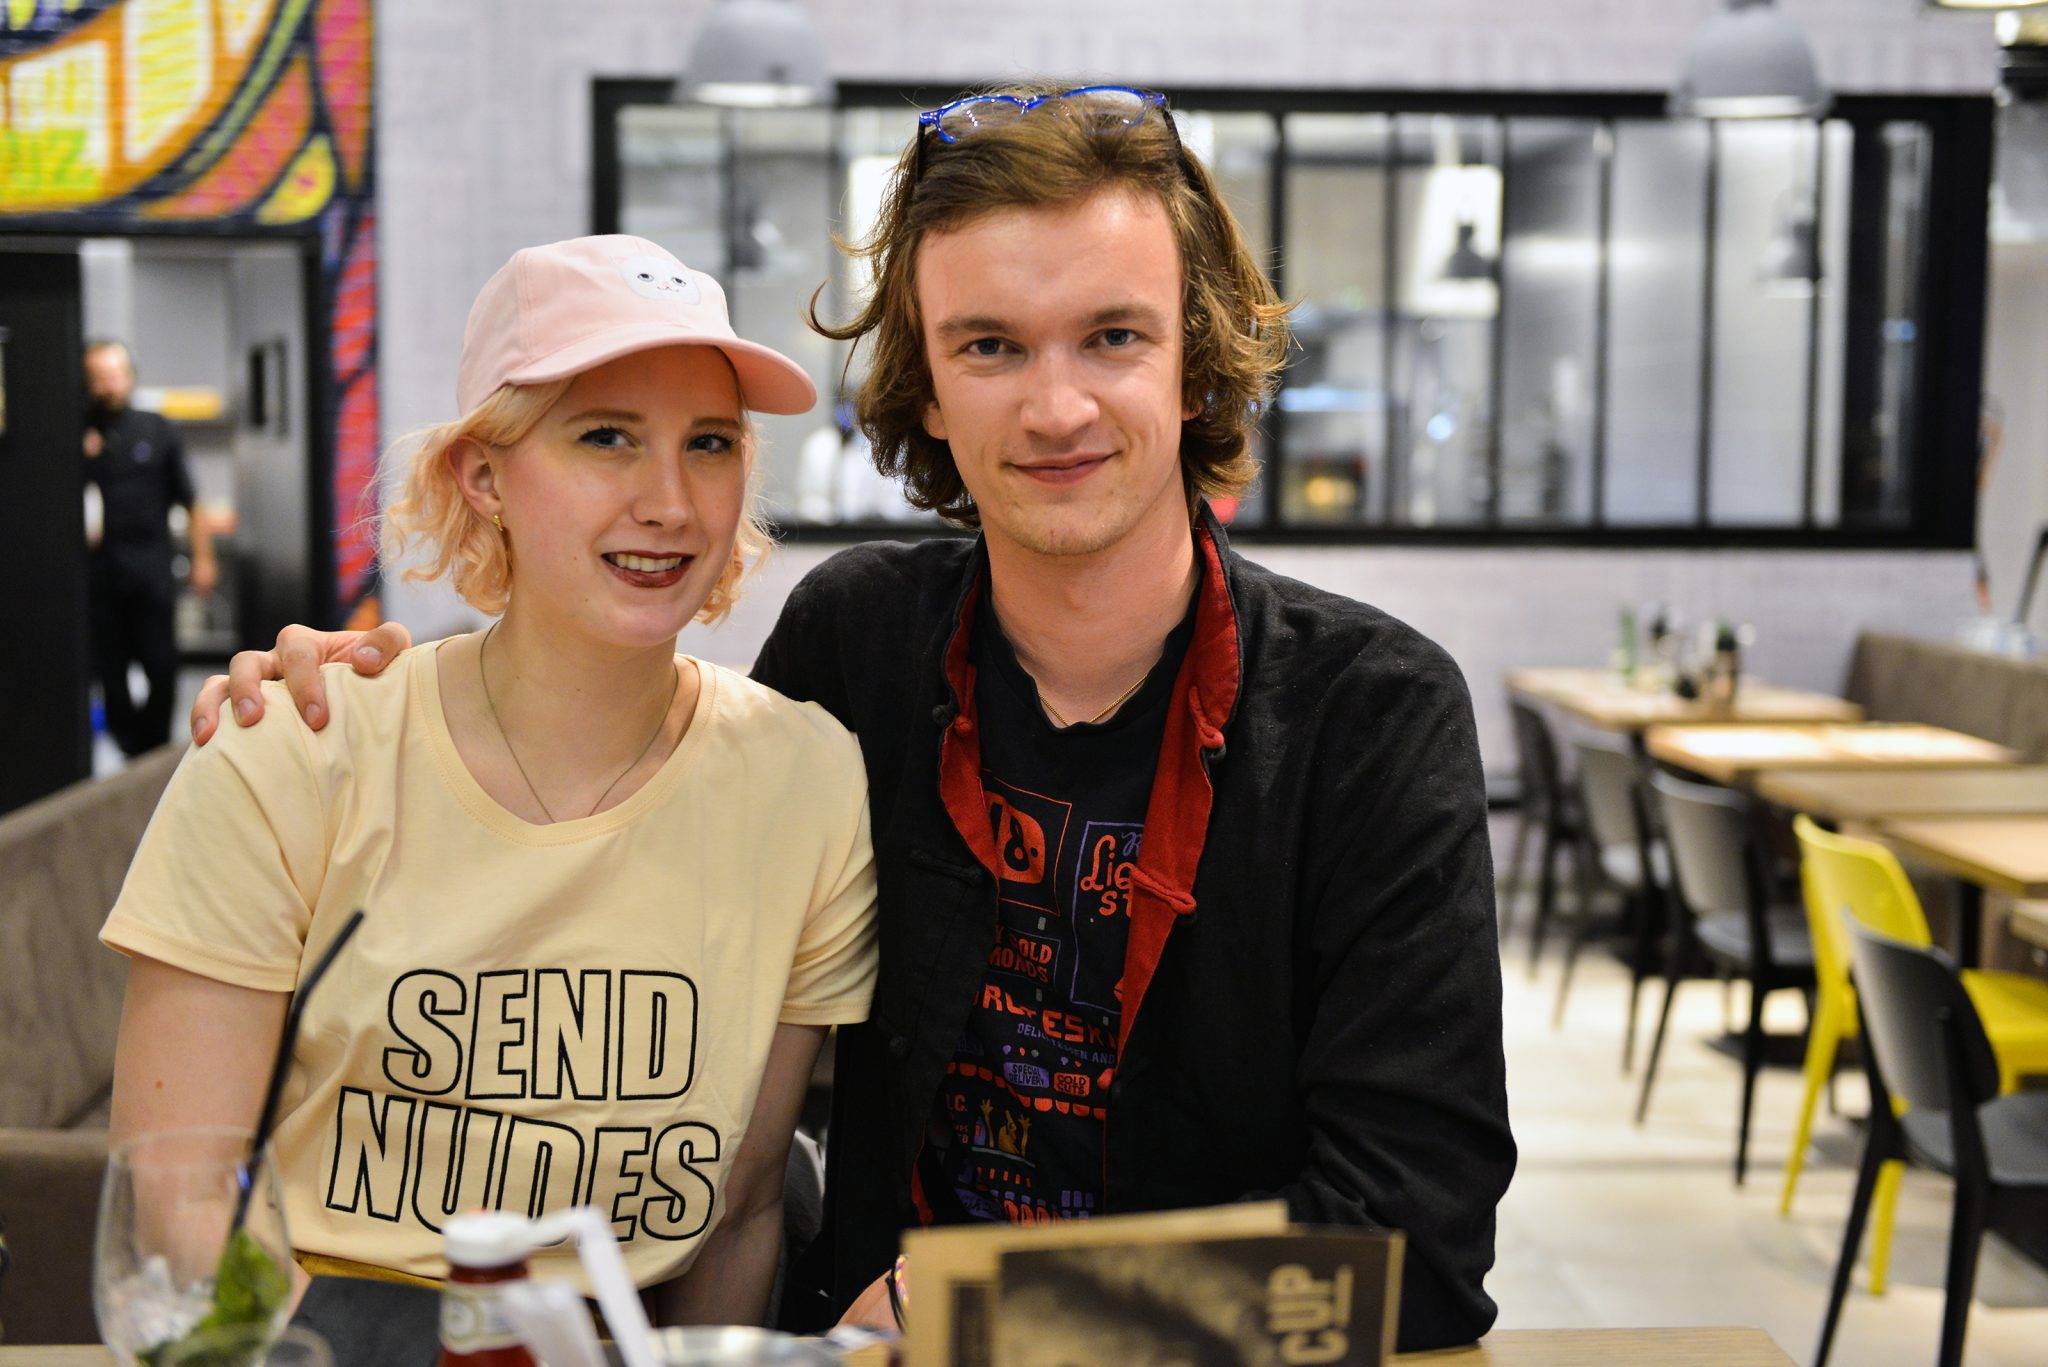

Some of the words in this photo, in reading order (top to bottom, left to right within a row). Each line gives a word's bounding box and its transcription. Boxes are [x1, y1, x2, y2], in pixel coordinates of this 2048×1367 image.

[383, 969, 698, 1100] SEND
[326, 1086, 720, 1247] NUDES
[1268, 1263, 1350, 1365] CUP
